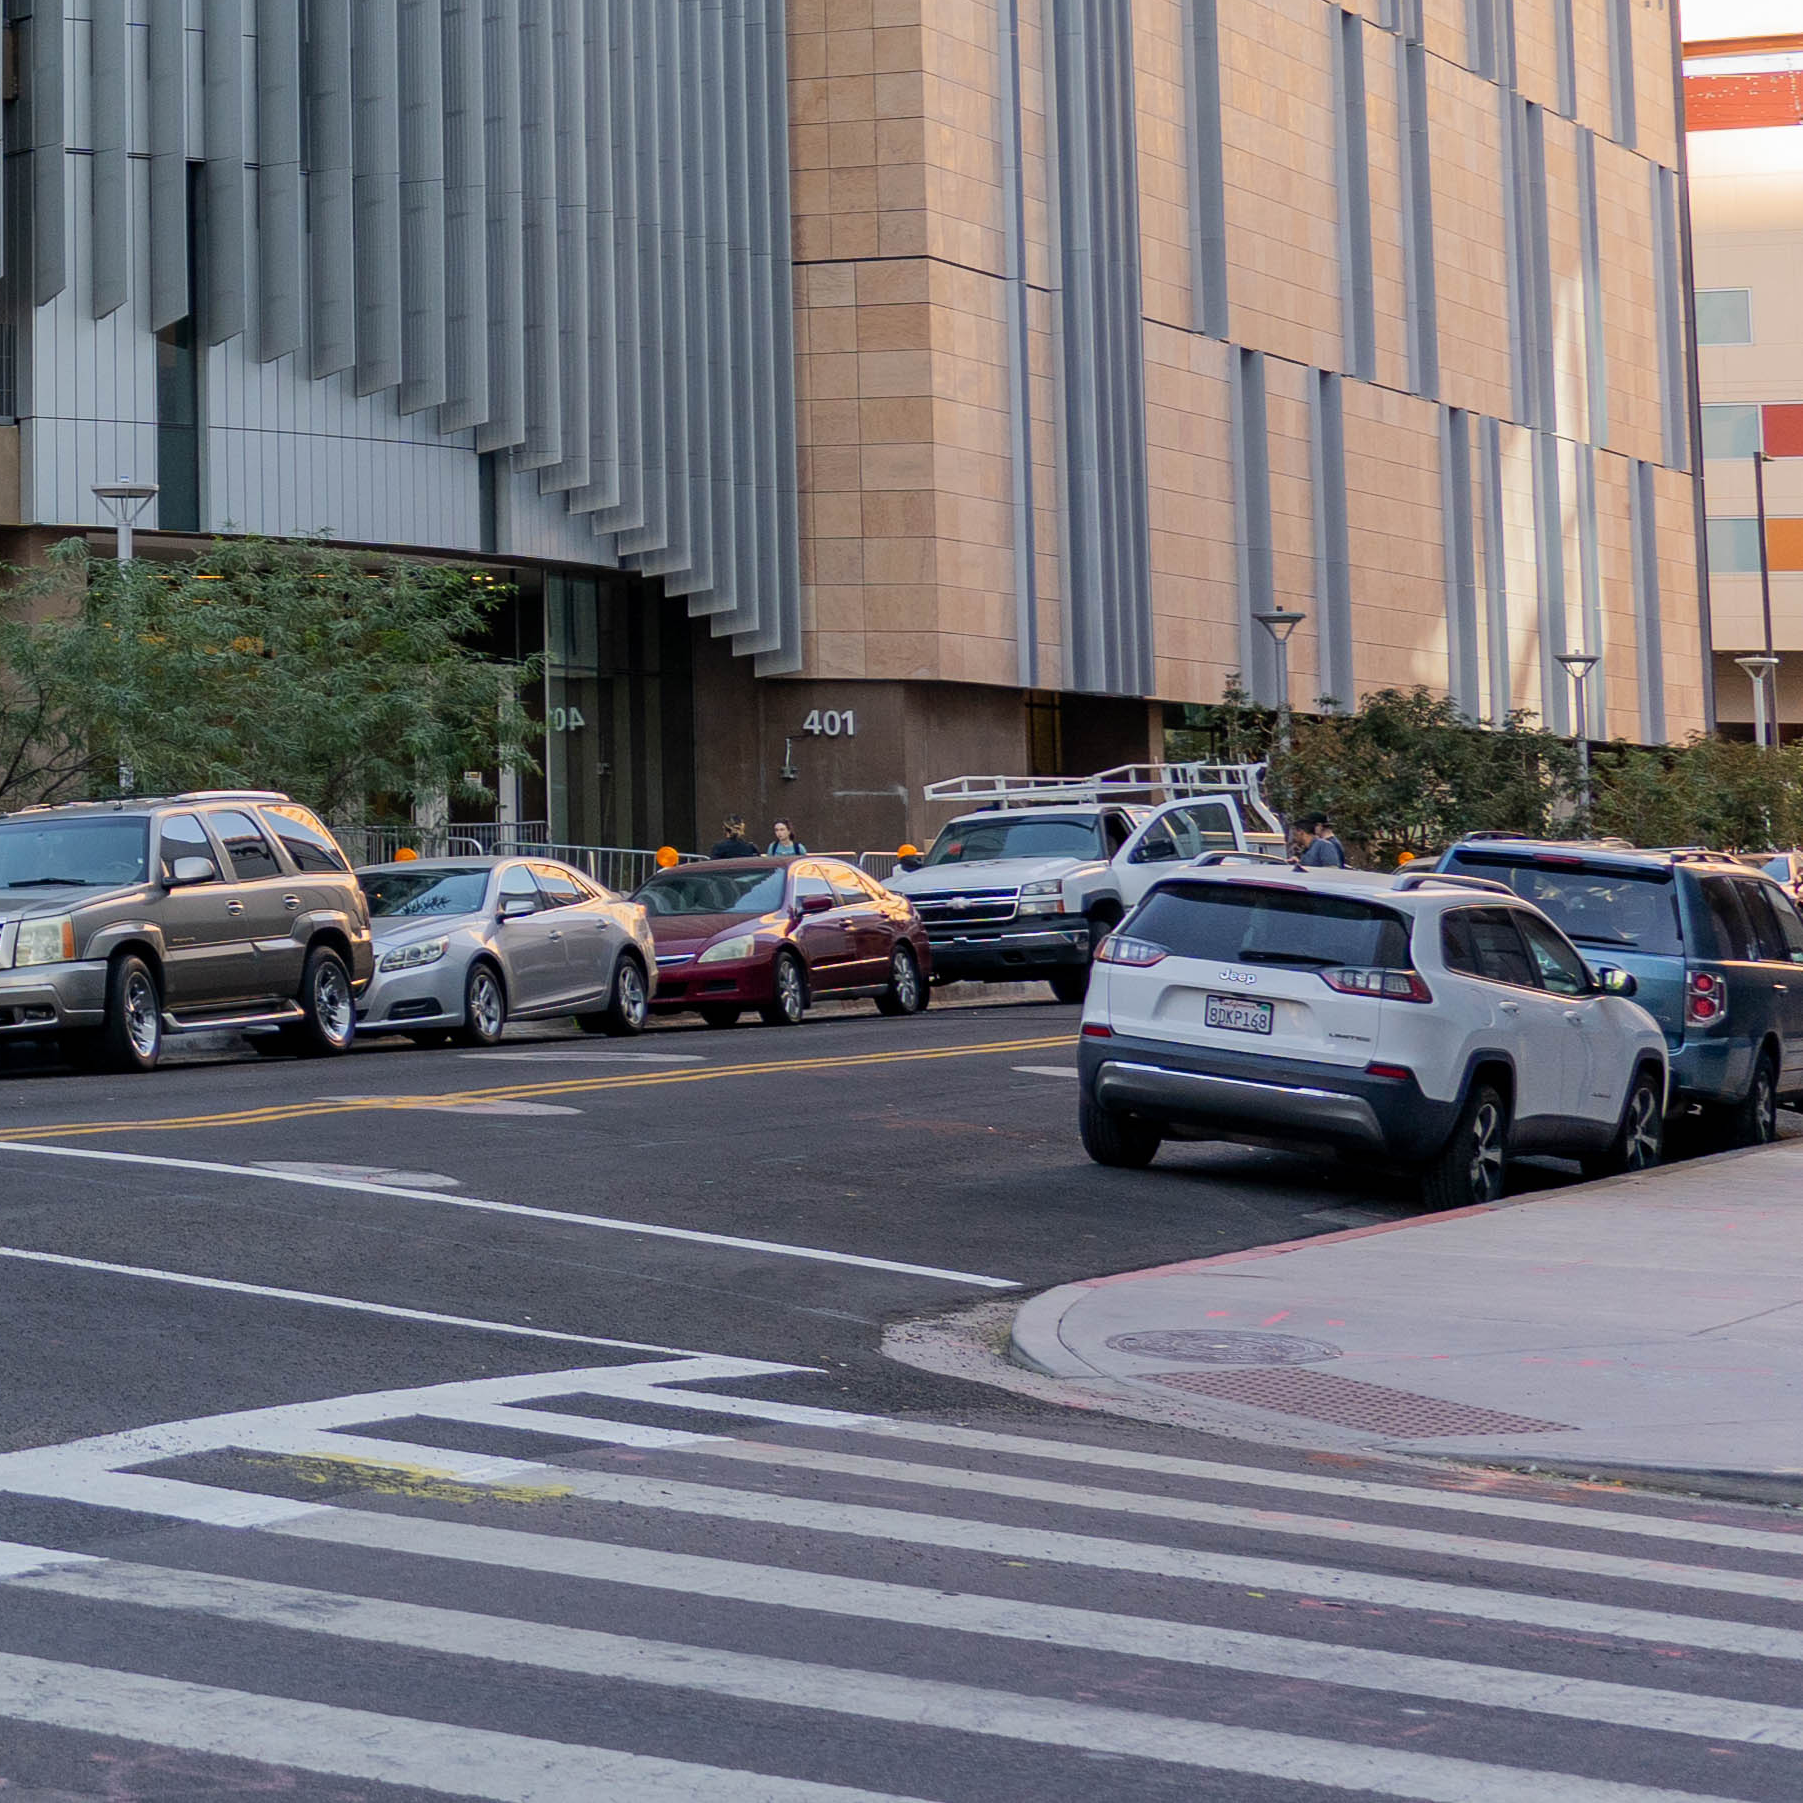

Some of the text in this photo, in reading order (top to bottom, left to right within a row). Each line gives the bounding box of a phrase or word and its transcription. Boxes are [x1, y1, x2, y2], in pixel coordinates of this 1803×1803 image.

[802, 709, 854, 736] 401
[1219, 968, 1257, 986] Jeep
[1209, 1007, 1268, 1029] 8DKP168
